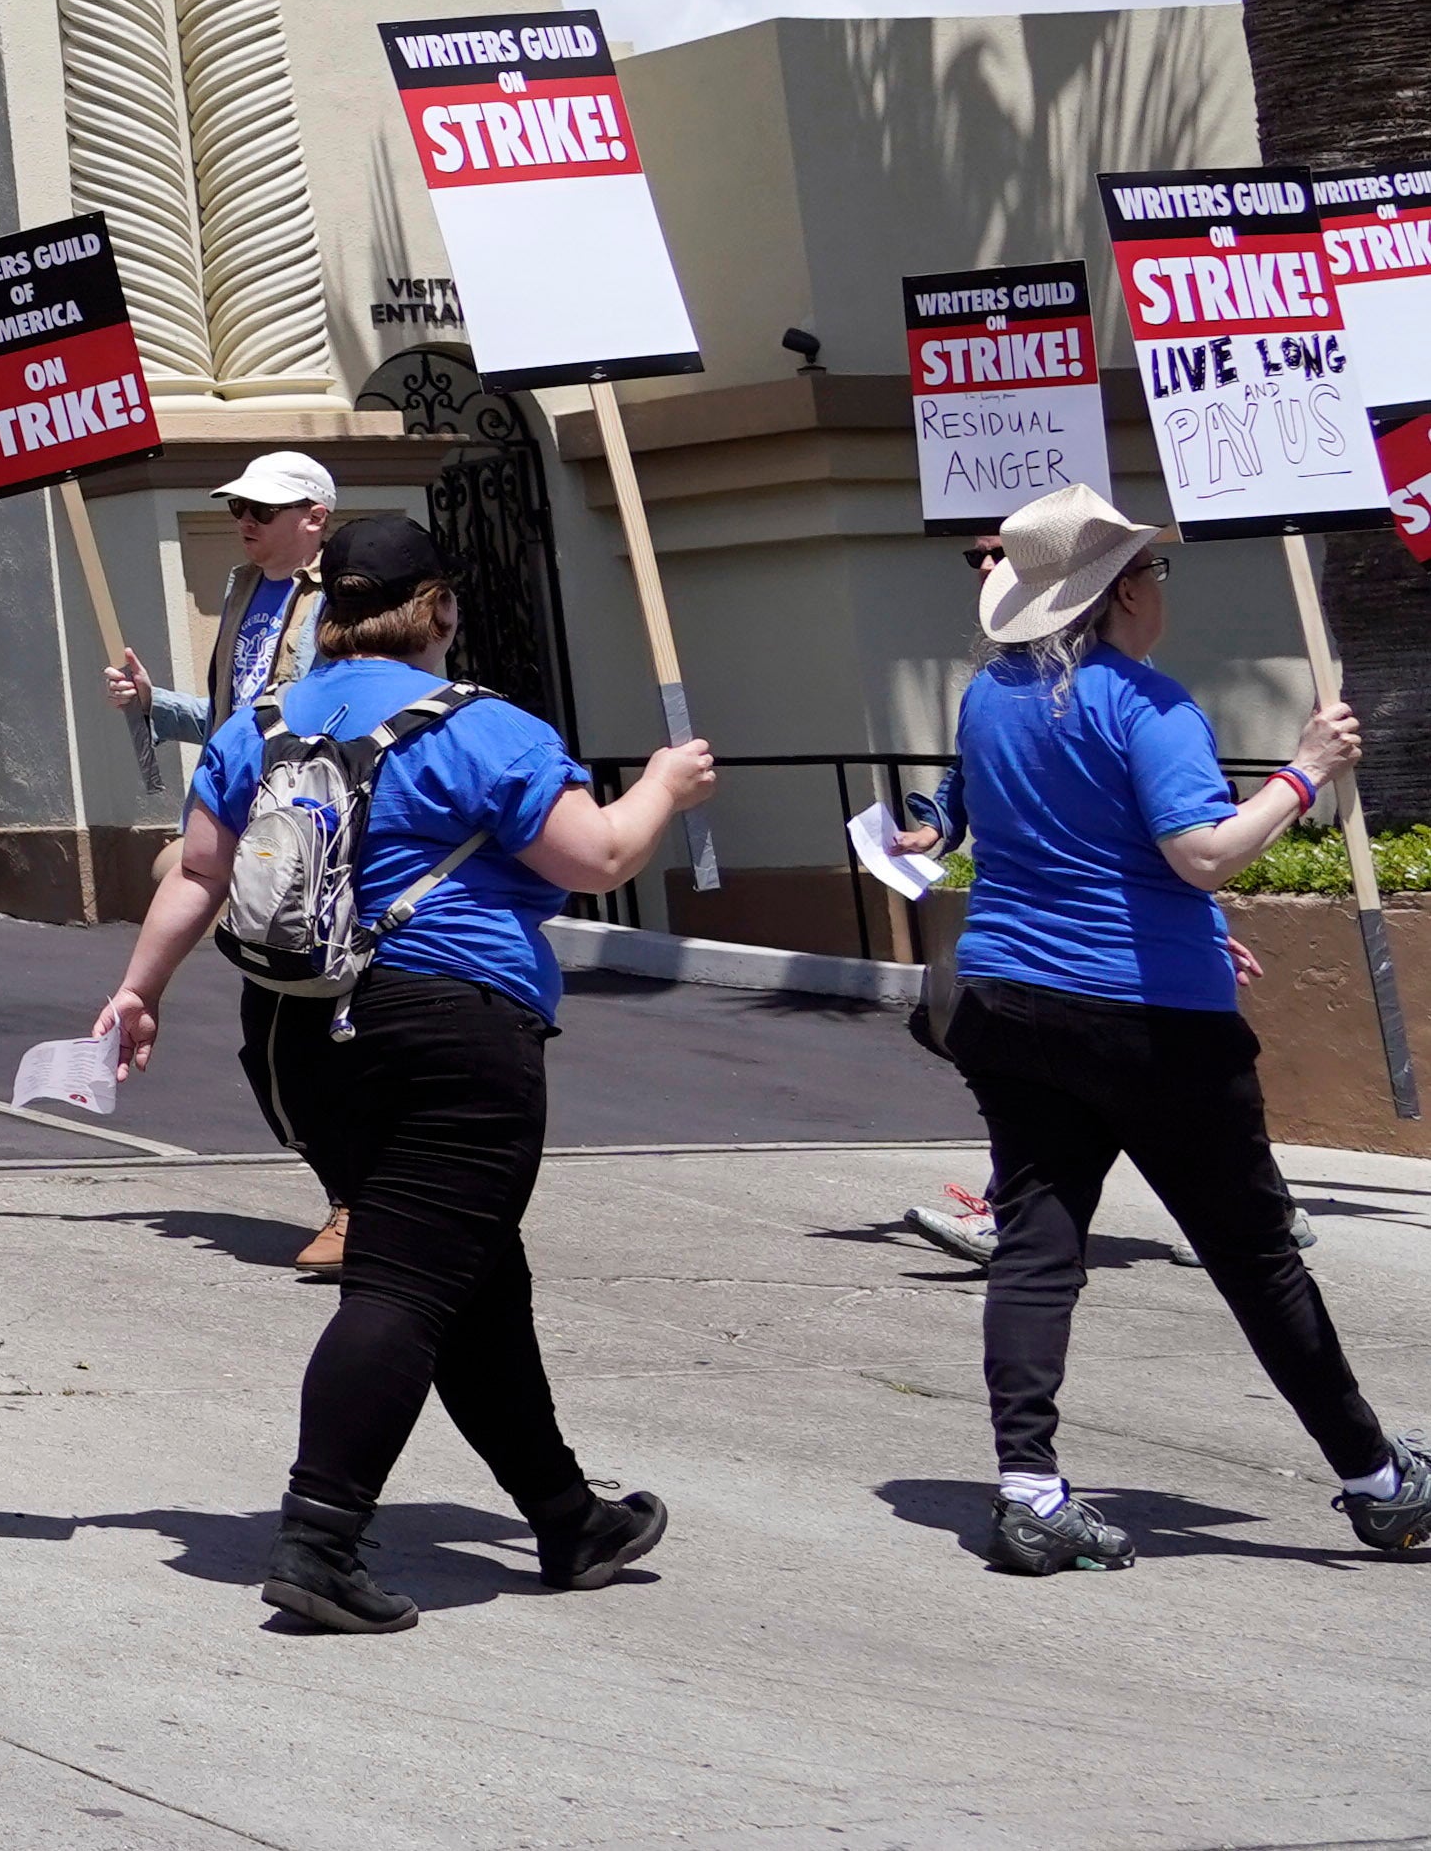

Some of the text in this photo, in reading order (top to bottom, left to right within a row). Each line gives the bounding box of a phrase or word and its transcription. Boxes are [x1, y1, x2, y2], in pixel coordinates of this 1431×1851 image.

[395, 25, 597, 68] WRITERS GUILD
[498, 71, 527, 93] ON
[422, 95, 626, 172] STRIKE!
[1393, 170, 1431, 197] GUI
[1113, 182, 1305, 220] WRITERS GUILD
[1376, 203, 1398, 220] ON
[34, 234, 100, 269] GUILD
[1210, 226, 1236, 247] ON
[1322, 219, 1431, 276] STRIK
[11, 283, 33, 304] OF
[387, 278, 452, 299] VISIT
[916, 283, 1074, 315] WRITERS GUILD
[1133, 252, 1328, 324] STRIKE!
[371, 304, 458, 323] ENTRA
[987, 315, 1006, 330] ON
[921, 328, 1082, 385] STRIKE!
[1151, 333, 1347, 399] LIVE LONG
[25, 357, 66, 390] ON
[1244, 382, 1280, 401] AND
[1164, 383, 1346, 488] PAY US
[944, 448, 1071, 495] ANGER
